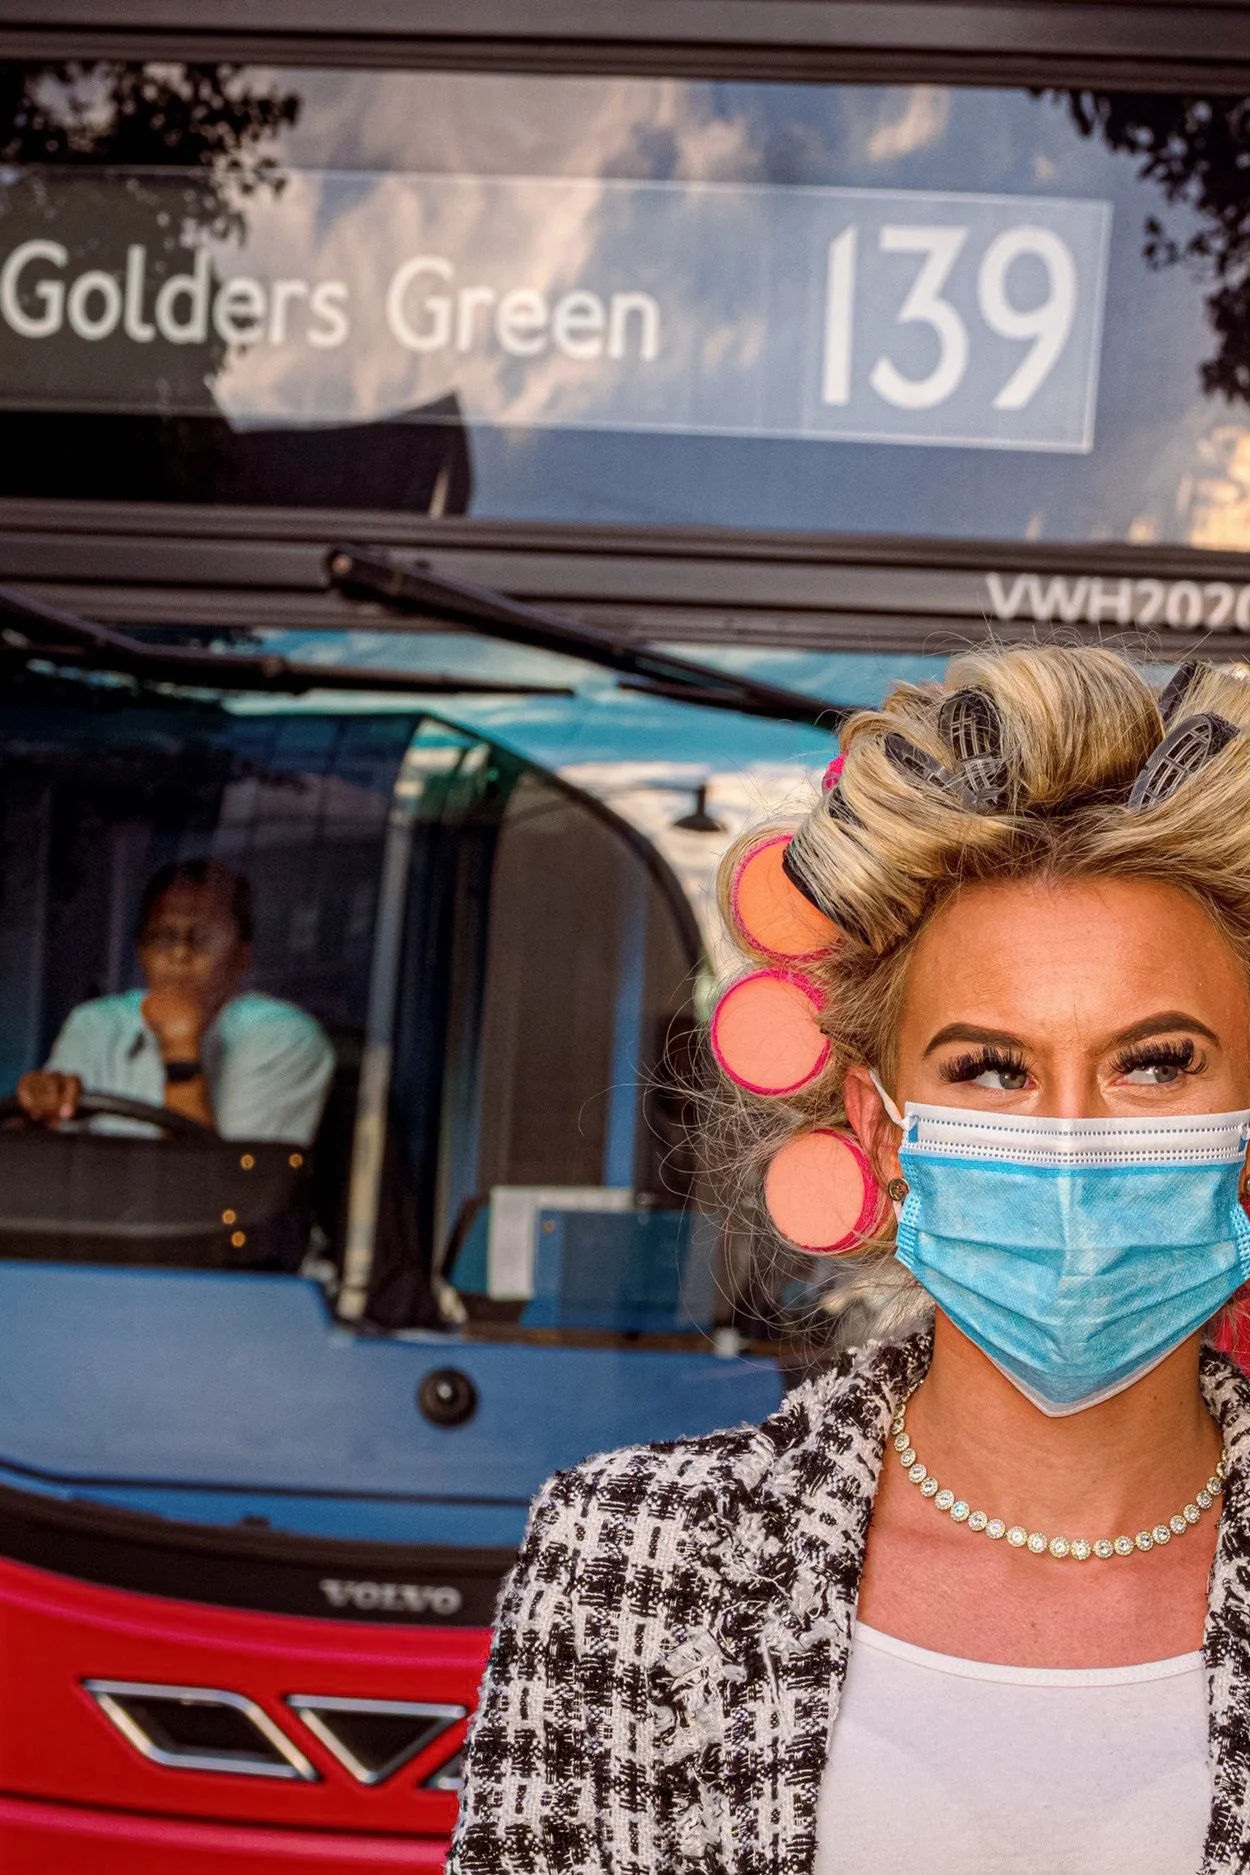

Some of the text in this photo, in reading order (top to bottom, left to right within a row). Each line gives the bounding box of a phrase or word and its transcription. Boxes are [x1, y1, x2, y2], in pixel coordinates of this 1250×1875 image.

[0, 238, 660, 362] Golders Green
[823, 225, 1077, 410] 139
[319, 1579, 461, 1615] VOLVO
